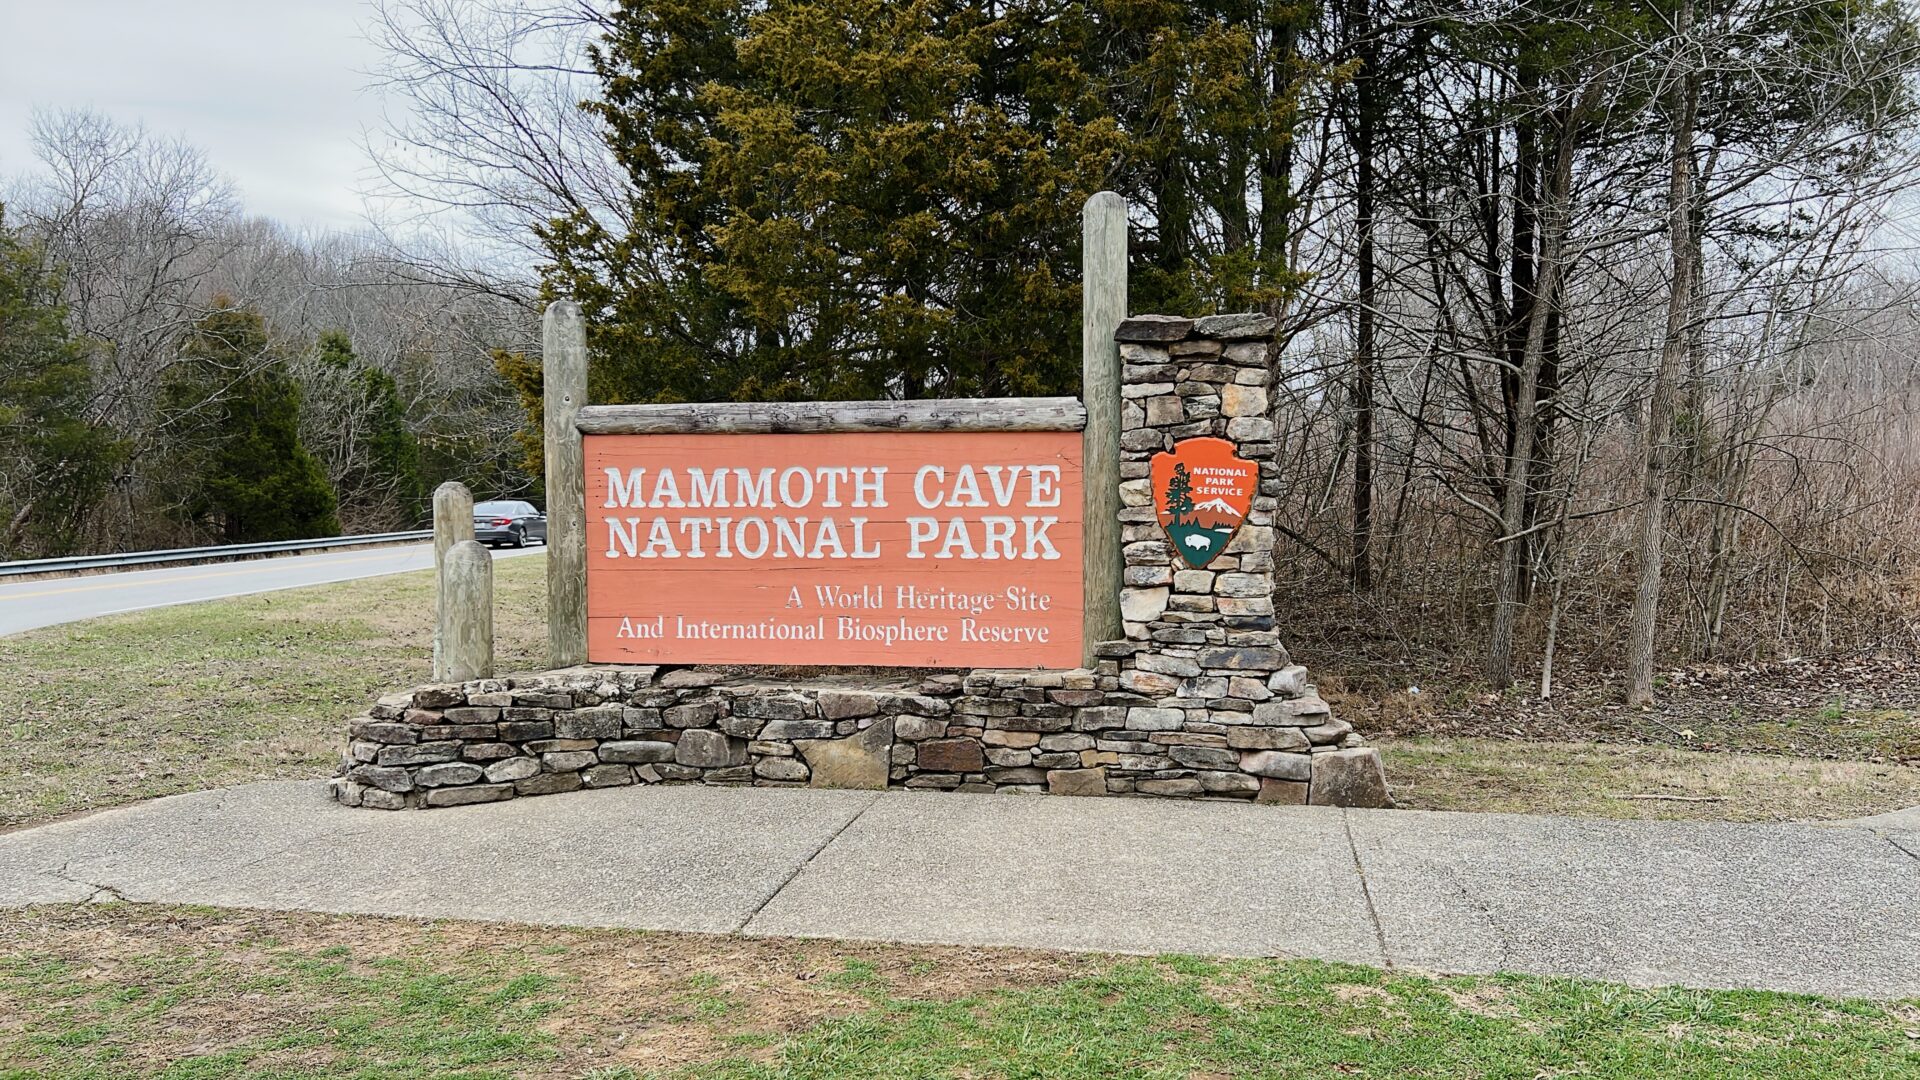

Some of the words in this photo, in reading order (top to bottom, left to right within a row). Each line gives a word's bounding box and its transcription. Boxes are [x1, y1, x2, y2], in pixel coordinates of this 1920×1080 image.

[603, 466, 889, 510] MAMMOTH
[913, 464, 1061, 509] CAVE
[1193, 467, 1248, 477] NATIONAL
[1205, 477, 1234, 486] PARK
[1196, 486, 1243, 497] SERVICE
[604, 516, 881, 560] NATIONAL
[905, 515, 1061, 560] PARK
[784, 585, 804, 610] A
[815, 585, 883, 609] World
[896, 585, 995, 616] Heritage
[1006, 586, 1051, 611] Site
[616, 615, 664, 639] And
[676, 616, 825, 641] International
[837, 617, 949, 647] Biosphere
[960, 618, 1049, 643] Reserve
